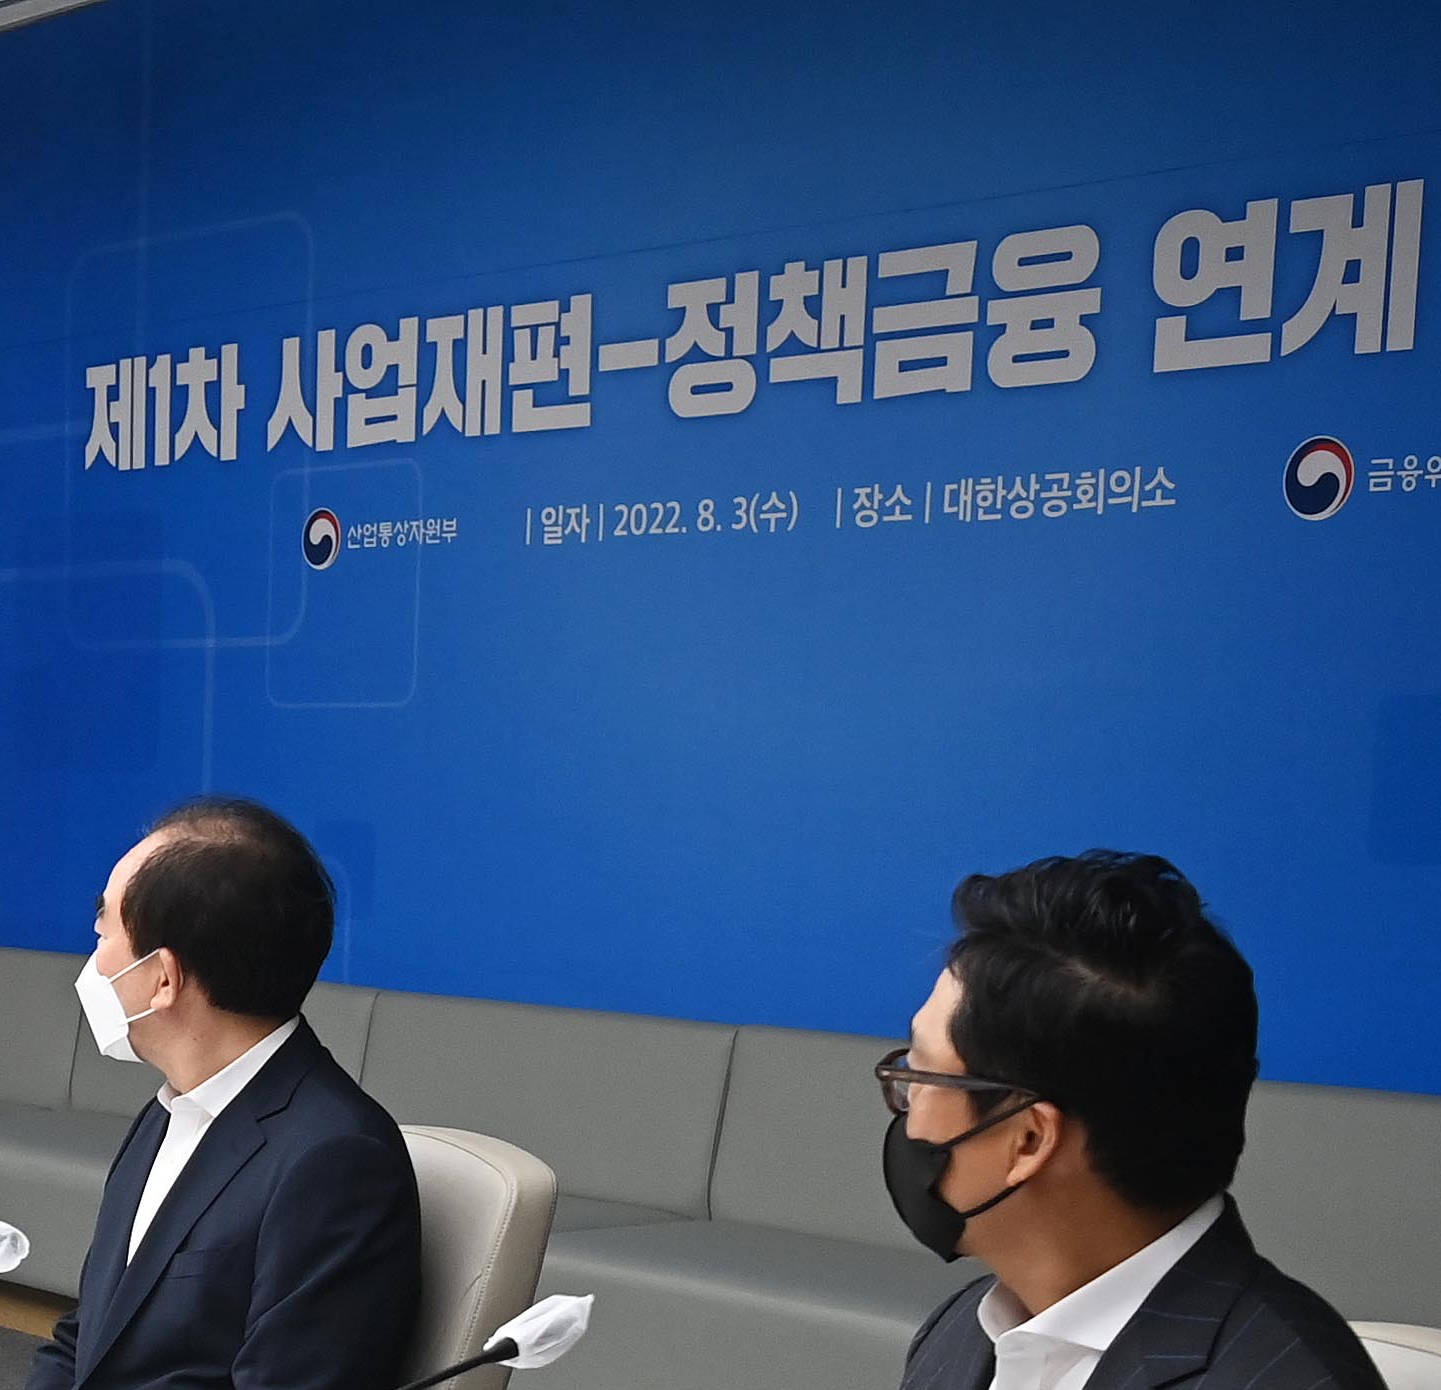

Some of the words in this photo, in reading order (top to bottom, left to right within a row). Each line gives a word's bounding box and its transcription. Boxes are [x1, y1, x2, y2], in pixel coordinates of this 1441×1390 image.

[84, 342, 246, 472] 제1차
[1153, 178, 1425, 373] 연계
[346, 517, 458, 549] 산업통상자원부
[539, 503, 592, 545] 일자
[612, 502, 688, 538] 2022.
[696, 498, 723, 532] 8.
[731, 490, 800, 534] 3(수)
[852, 483, 914, 529] 장소
[943, 464, 1178, 524] 대한상공회의소
